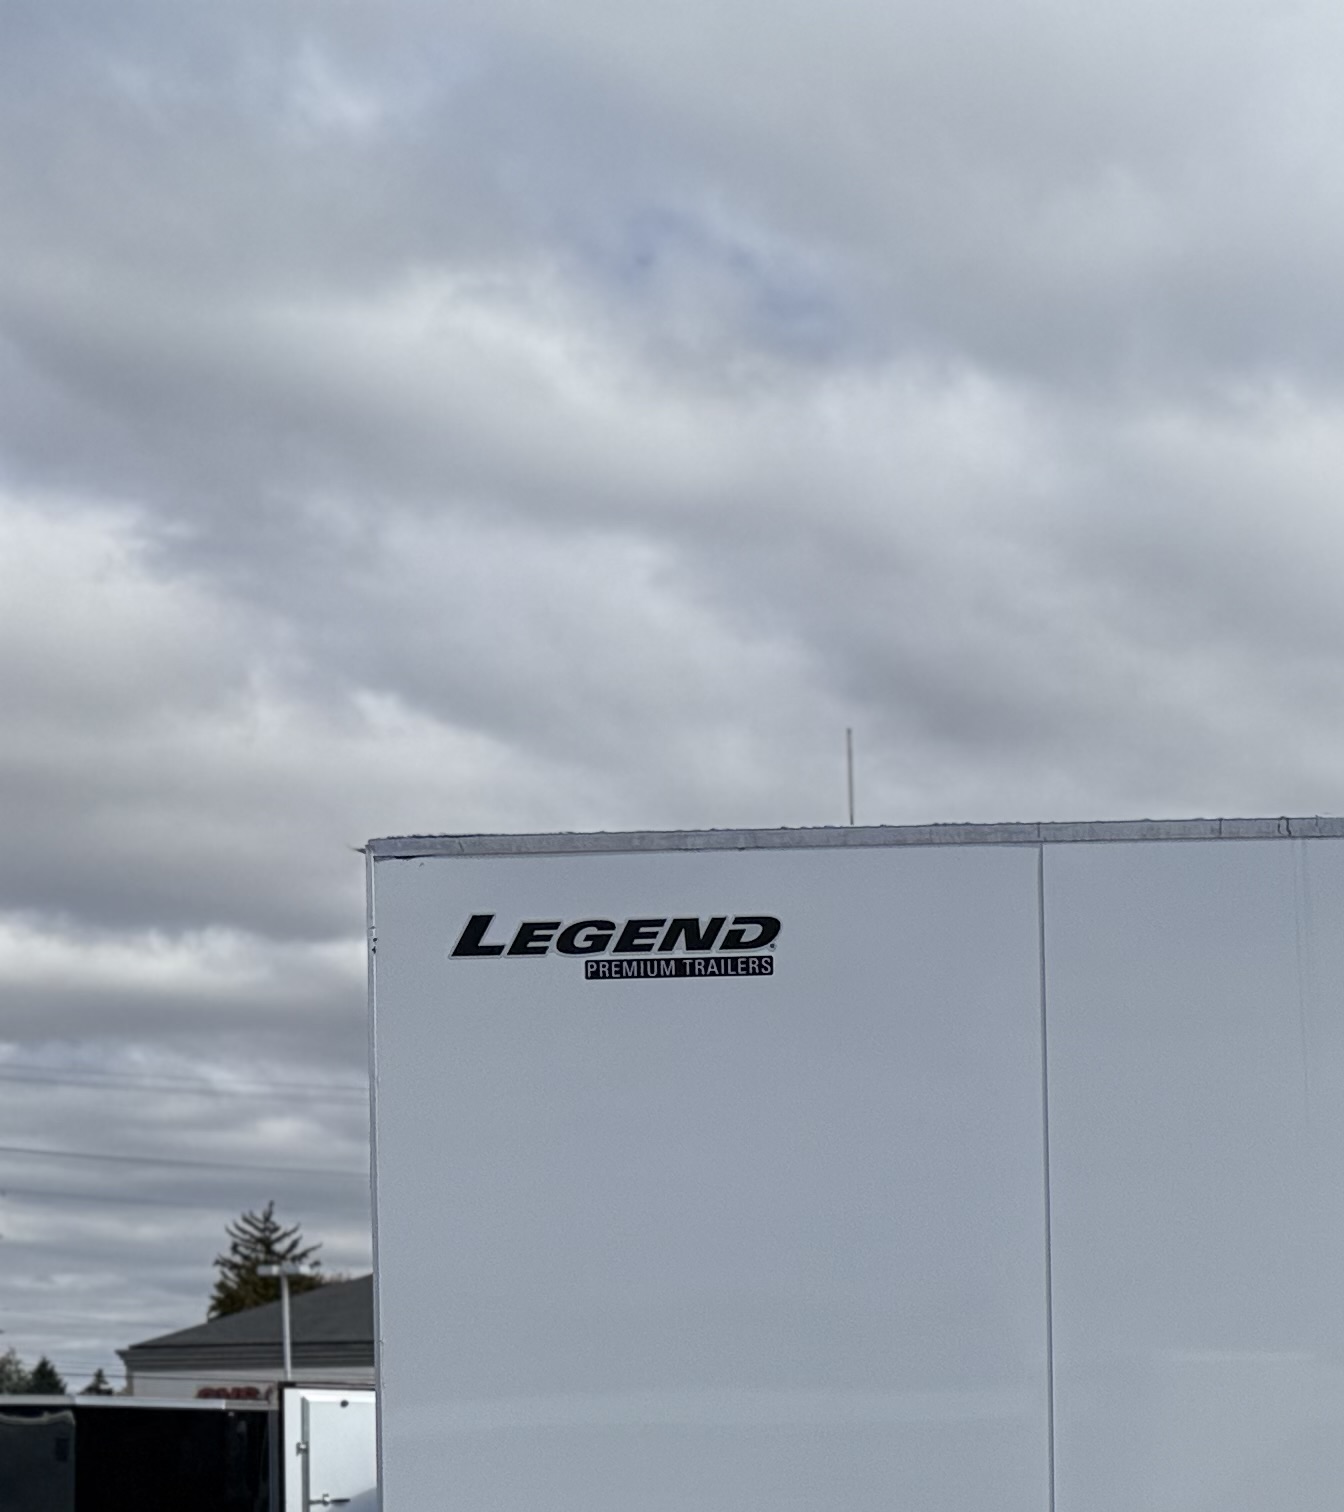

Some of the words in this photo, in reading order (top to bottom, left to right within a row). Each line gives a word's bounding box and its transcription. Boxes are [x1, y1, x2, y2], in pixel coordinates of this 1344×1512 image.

[451, 914, 781, 957] LEGEND
[586, 960, 676, 978] PREMIUM
[682, 958, 772, 976] TRAILERS
